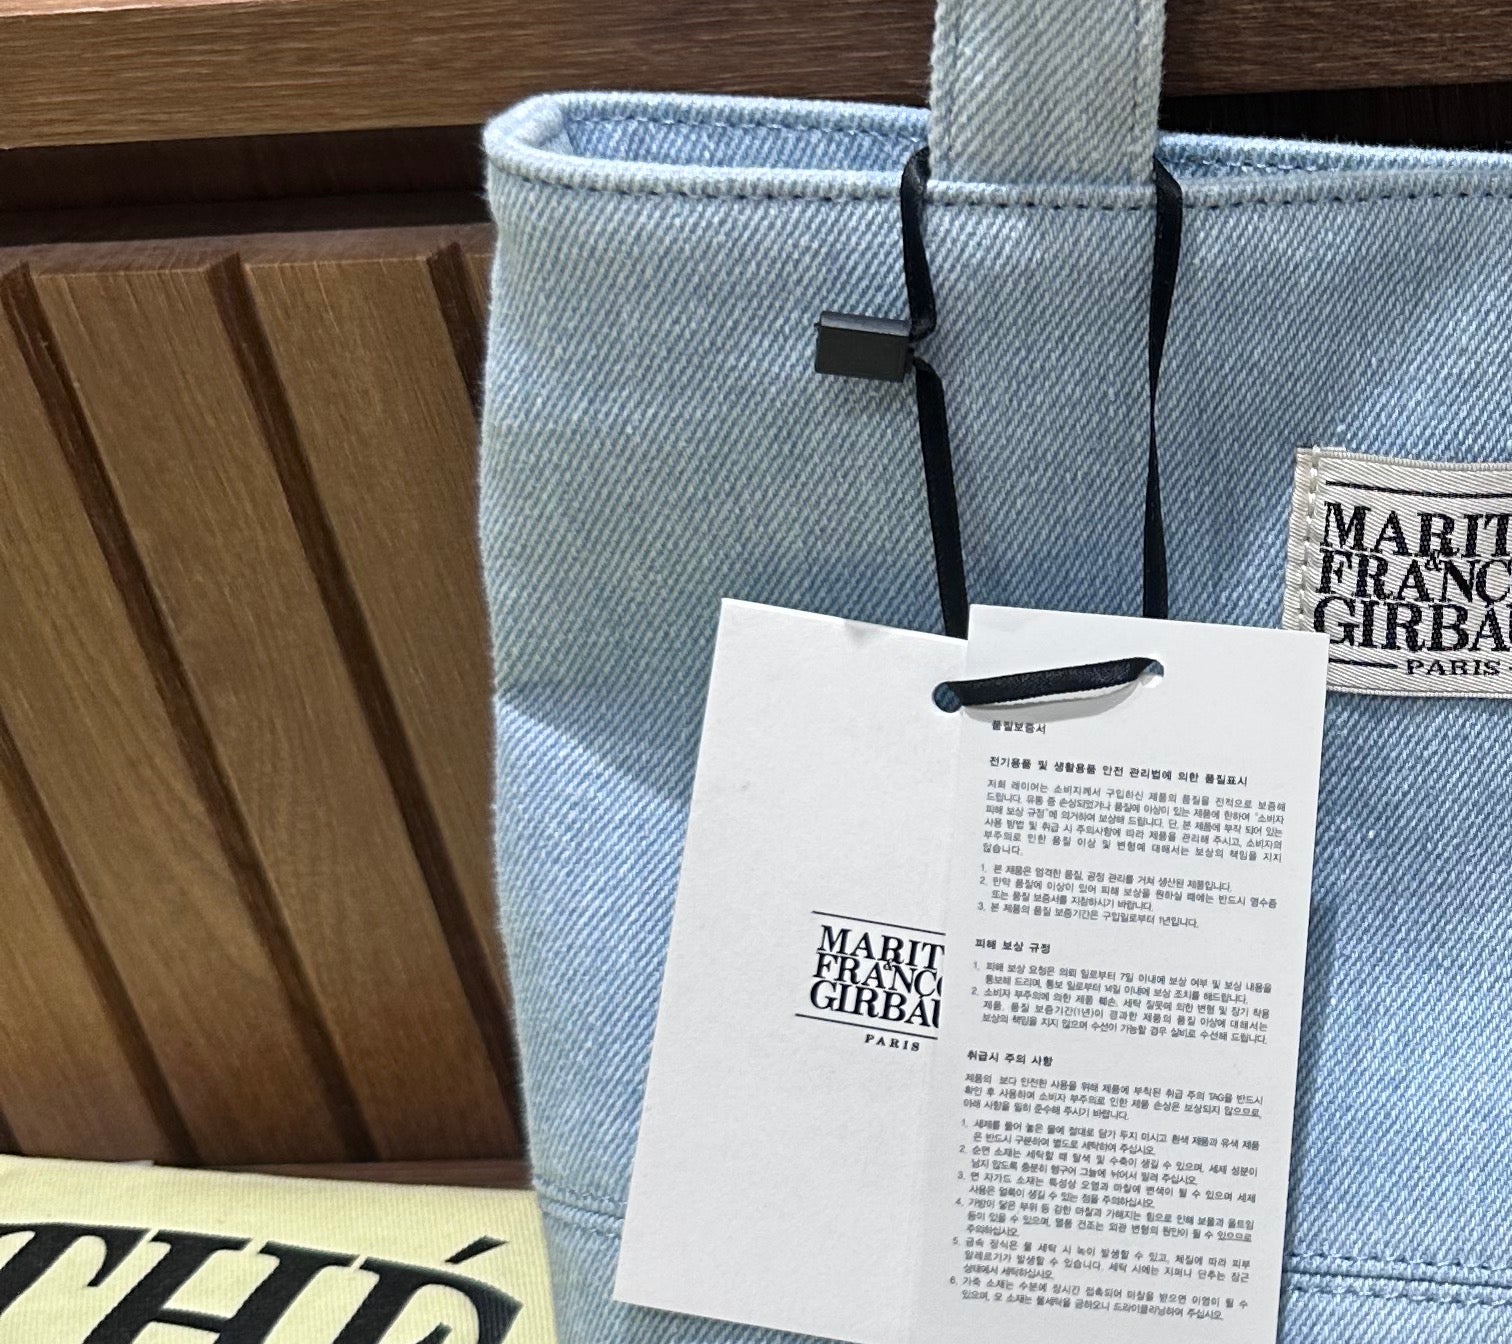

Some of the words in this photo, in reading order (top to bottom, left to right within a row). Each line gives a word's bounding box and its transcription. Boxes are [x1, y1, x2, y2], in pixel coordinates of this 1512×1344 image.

[1424, 554, 1445, 571] &
[1405, 659, 1501, 676] PARIS
[988, 755, 1032, 769] 전기용품
[1036, 759, 1048, 771] 및
[1053, 760, 1096, 775] 생활용품
[1101, 764, 1123, 777] 안전
[1128, 766, 1172, 781] 관리법에
[1177, 770, 1199, 783] 의한
[1204, 773, 1247, 787] 품질표시
[974, 937, 996, 949] 피해
[1001, 939, 1024, 952] 보상
[1028, 942, 1050, 954] 규정
[865, 1034, 920, 1052] PARIS
[966, 1049, 999, 1063] 취급시
[1003, 1052, 1026, 1065] 주의
[1030, 1054, 1053, 1067] 사항
